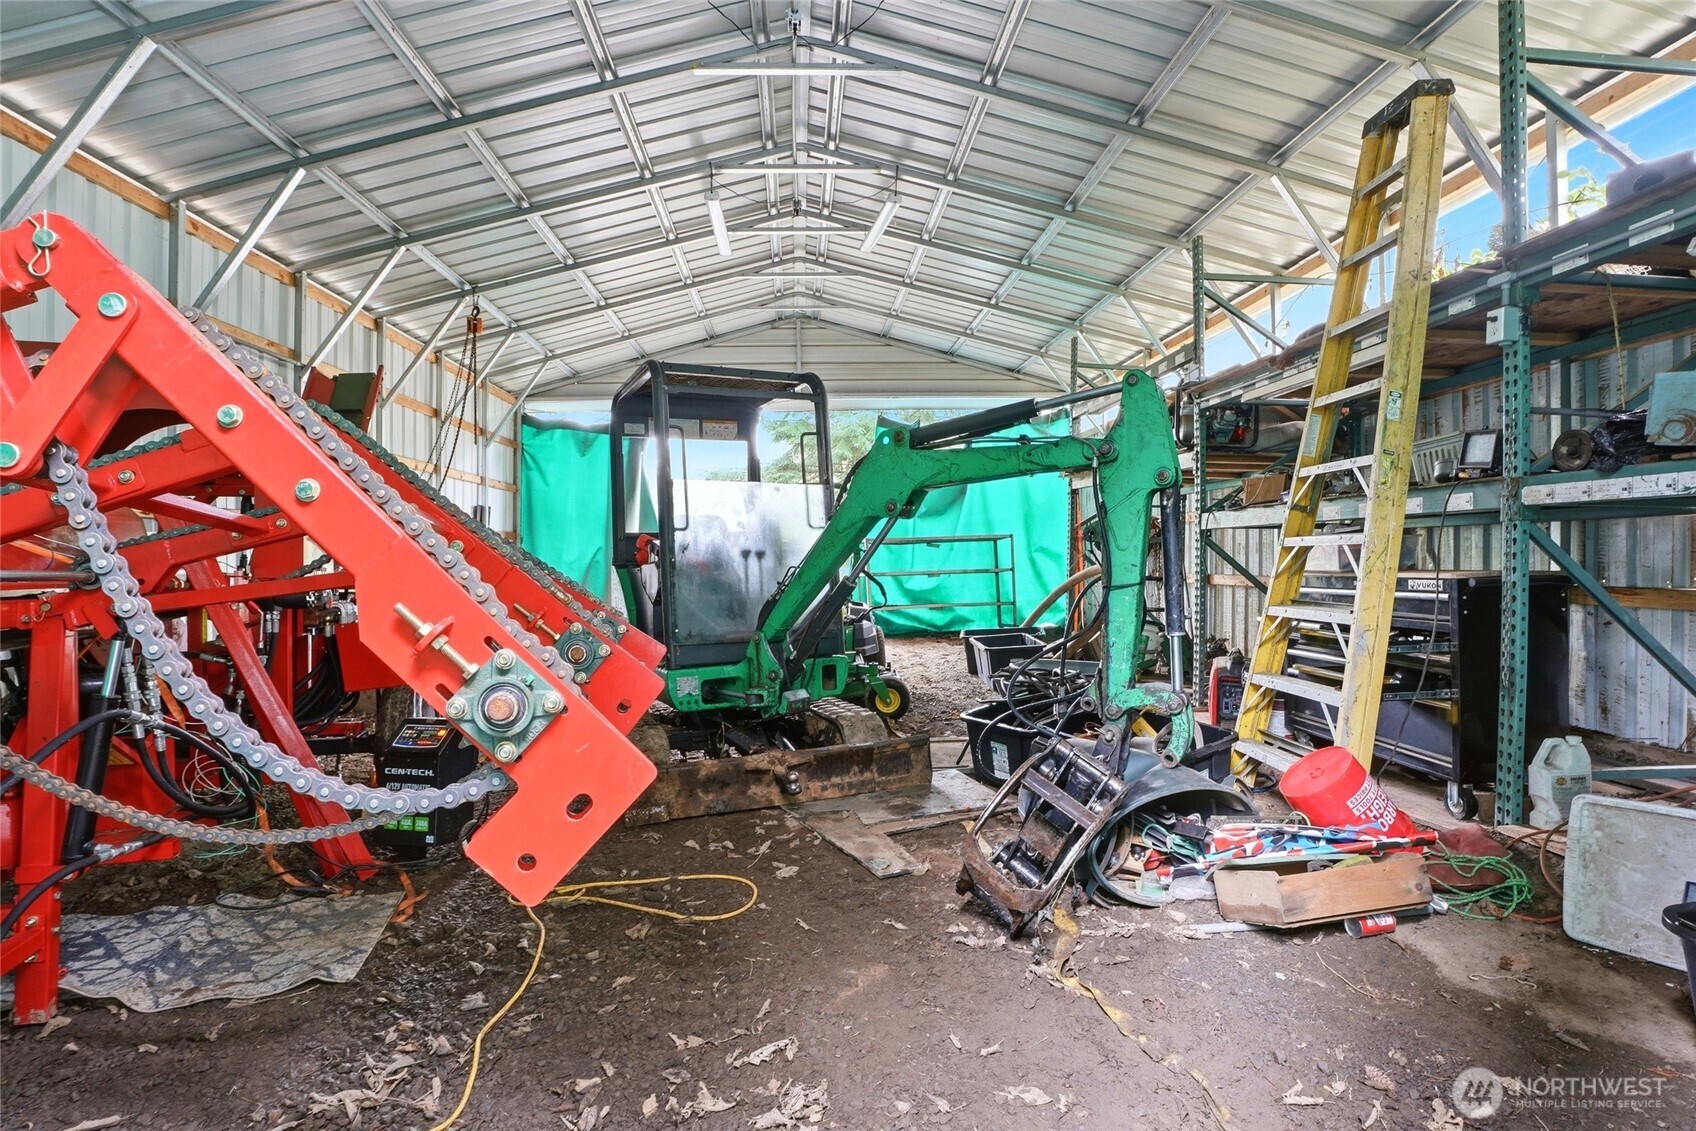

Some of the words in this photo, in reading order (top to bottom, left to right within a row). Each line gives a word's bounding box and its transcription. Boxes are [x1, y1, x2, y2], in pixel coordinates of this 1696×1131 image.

[385, 768, 434, 776] CEN-TECH
[1349, 785, 1369, 806] PRICES
[1355, 794, 1373, 814] TOOLS
